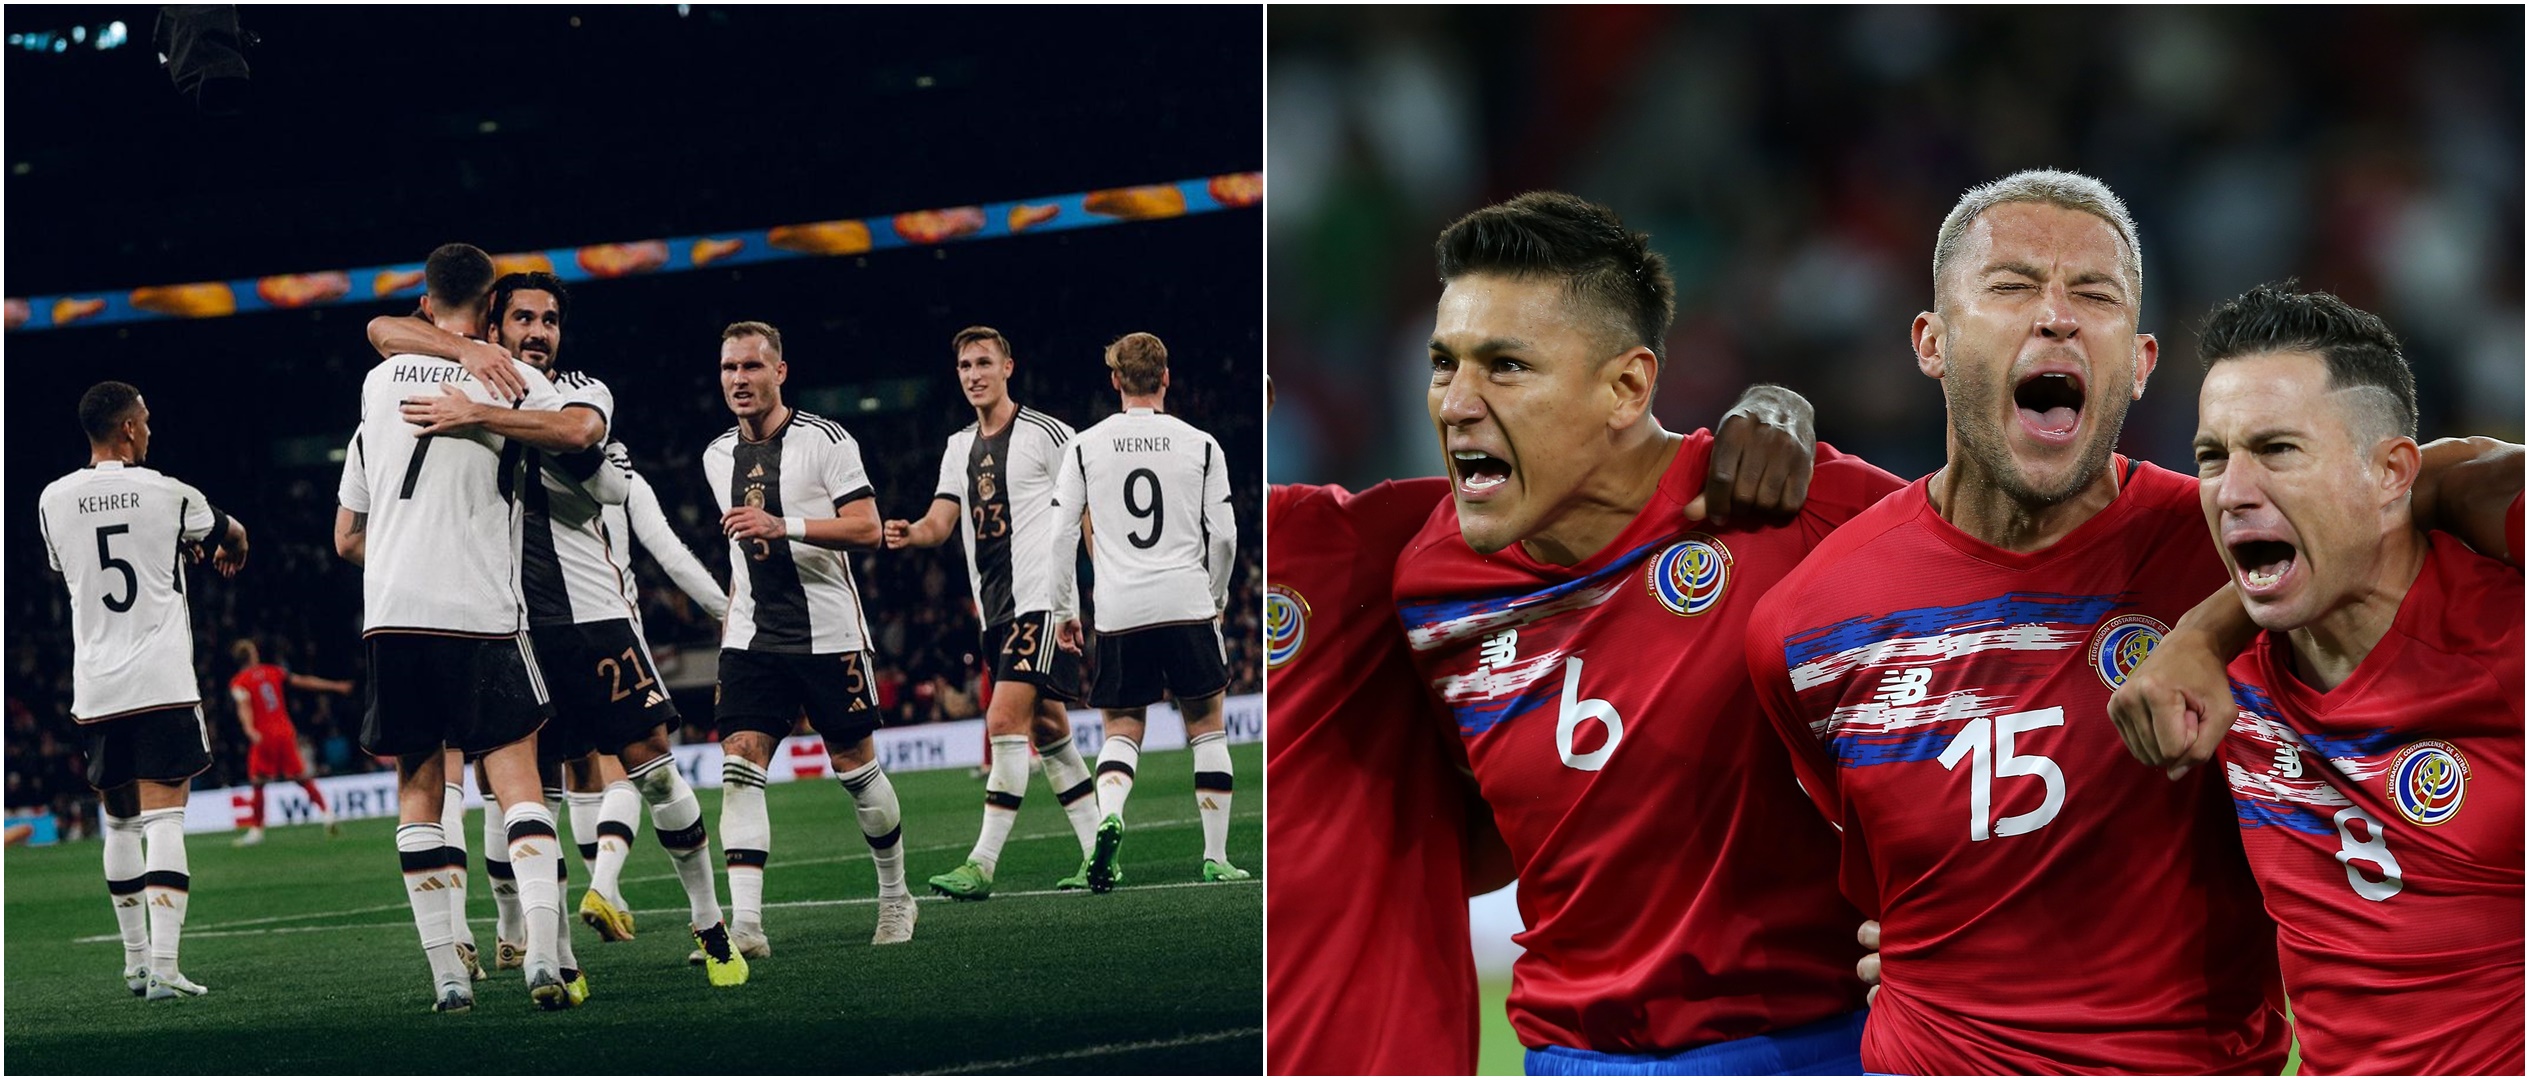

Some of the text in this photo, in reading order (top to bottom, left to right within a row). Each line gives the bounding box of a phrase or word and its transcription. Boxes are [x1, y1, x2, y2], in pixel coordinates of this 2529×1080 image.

[392, 364, 473, 384] HAVERTZ
[1112, 437, 1171, 453] WERNER
[78, 492, 140, 514] KEHRER
[972, 504, 1007, 540] 23
[1123, 467, 1164, 549] 9
[96, 523, 138, 613] 5
[1002, 622, 1039, 655] 23
[597, 646, 656, 703] 21
[840, 652, 865, 694] 3
[1556, 655, 1624, 771] 6
[1936, 705, 2067, 842] 15
[2388, 741, 2468, 794] FEDERACION COSTARRICENSE DE FUTBOL
[2333, 805, 2404, 902] 8
